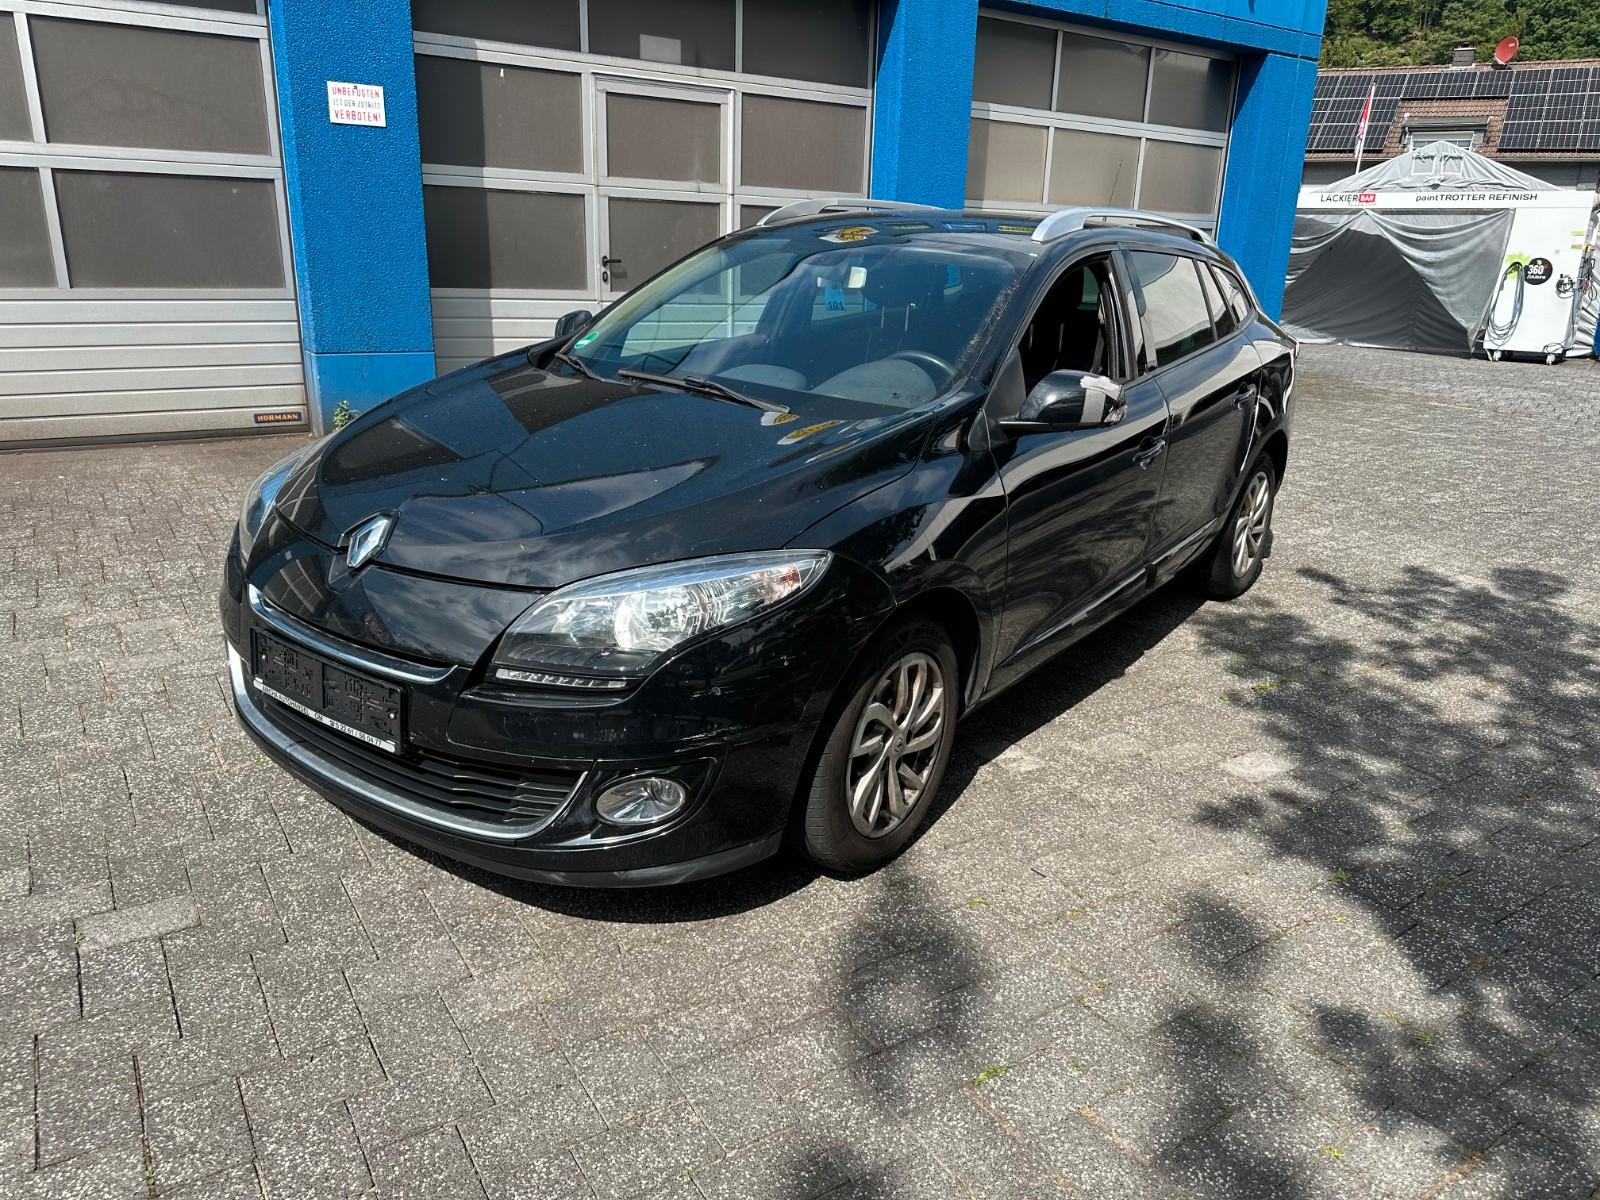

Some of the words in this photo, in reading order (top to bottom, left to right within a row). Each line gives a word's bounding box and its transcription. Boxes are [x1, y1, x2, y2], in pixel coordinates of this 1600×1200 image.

[332, 86, 380, 99] UNBEFUGTEN
[334, 109, 382, 122] VERBOTEN!
[1488, 193, 1538, 201] REFINISH
[1527, 264, 1545, 275] 360
